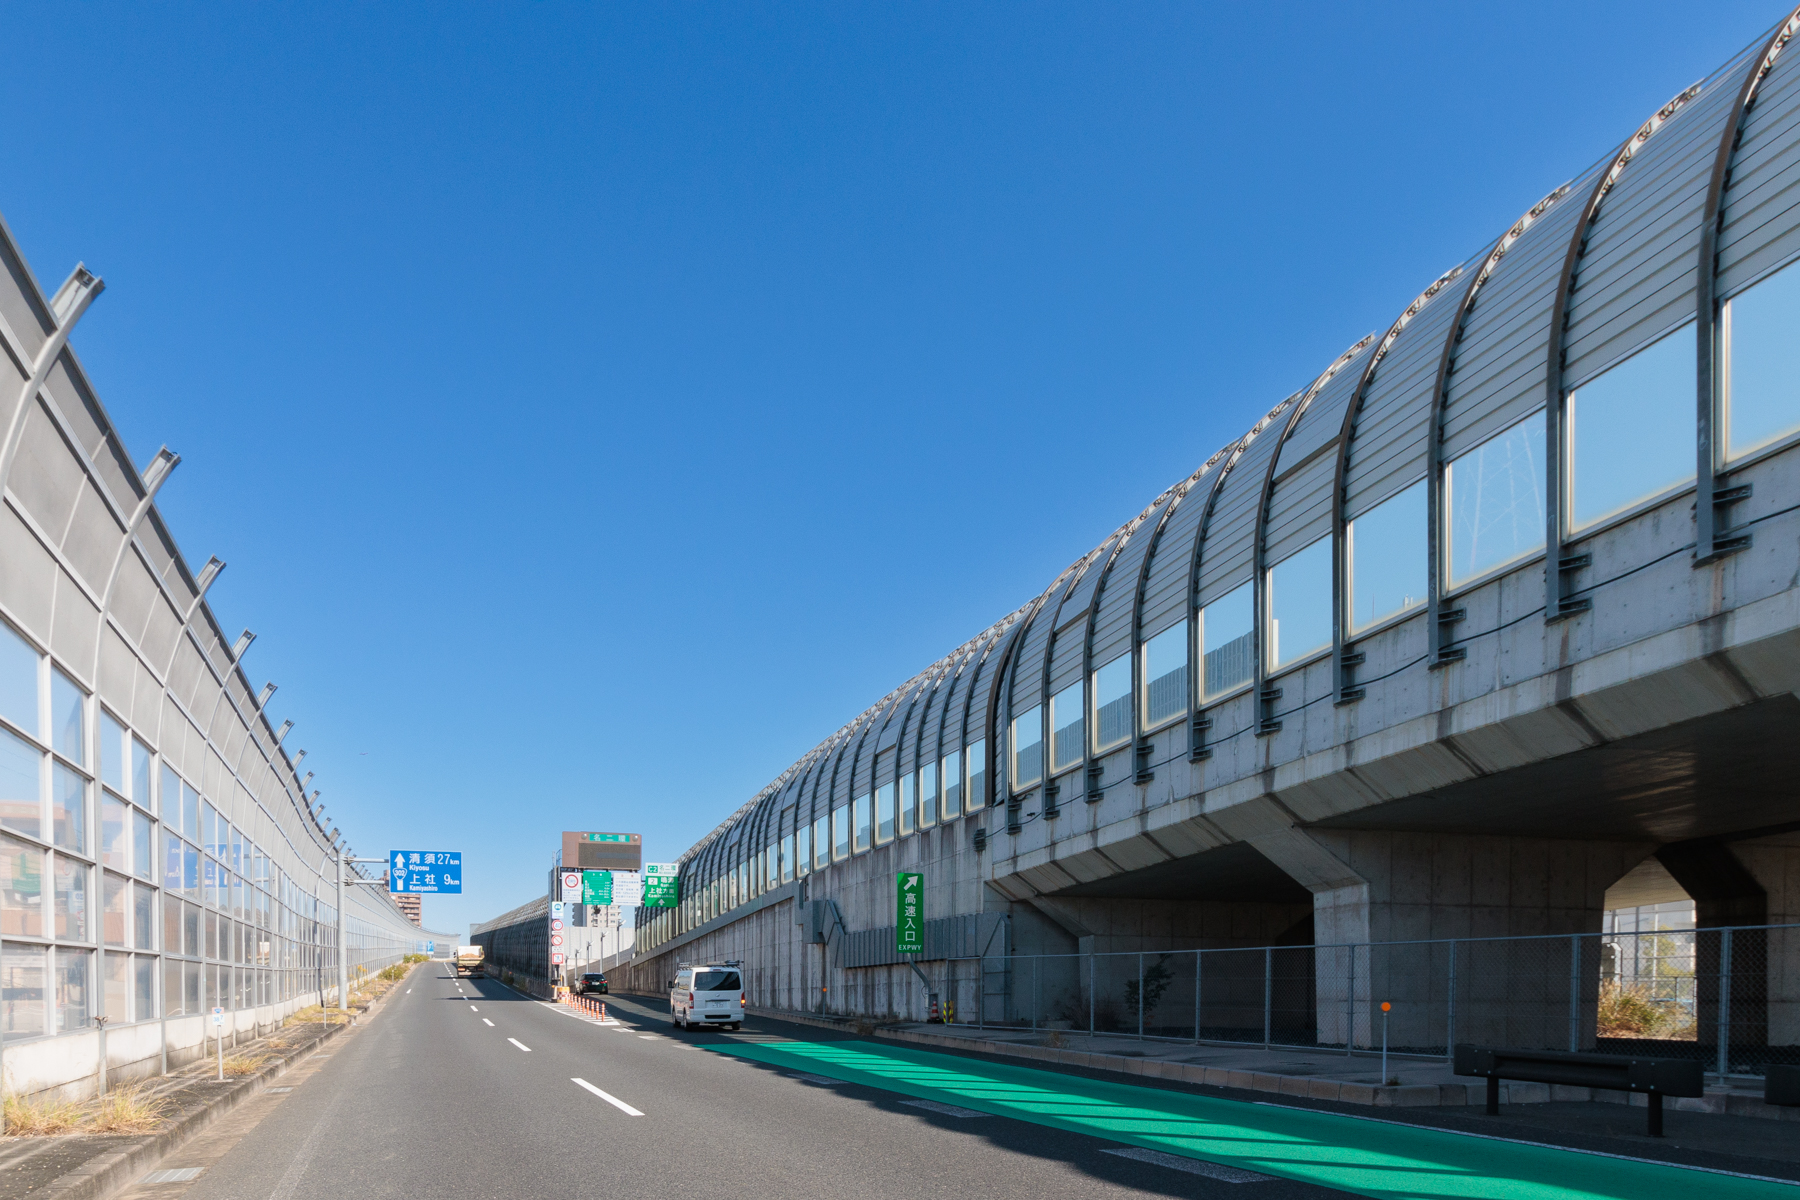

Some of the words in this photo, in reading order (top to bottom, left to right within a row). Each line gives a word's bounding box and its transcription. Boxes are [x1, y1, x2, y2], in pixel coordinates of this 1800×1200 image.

[409, 853, 436, 864] 清須
[409, 873, 436, 884] 上社
[904, 892, 917, 942] 高速入口
